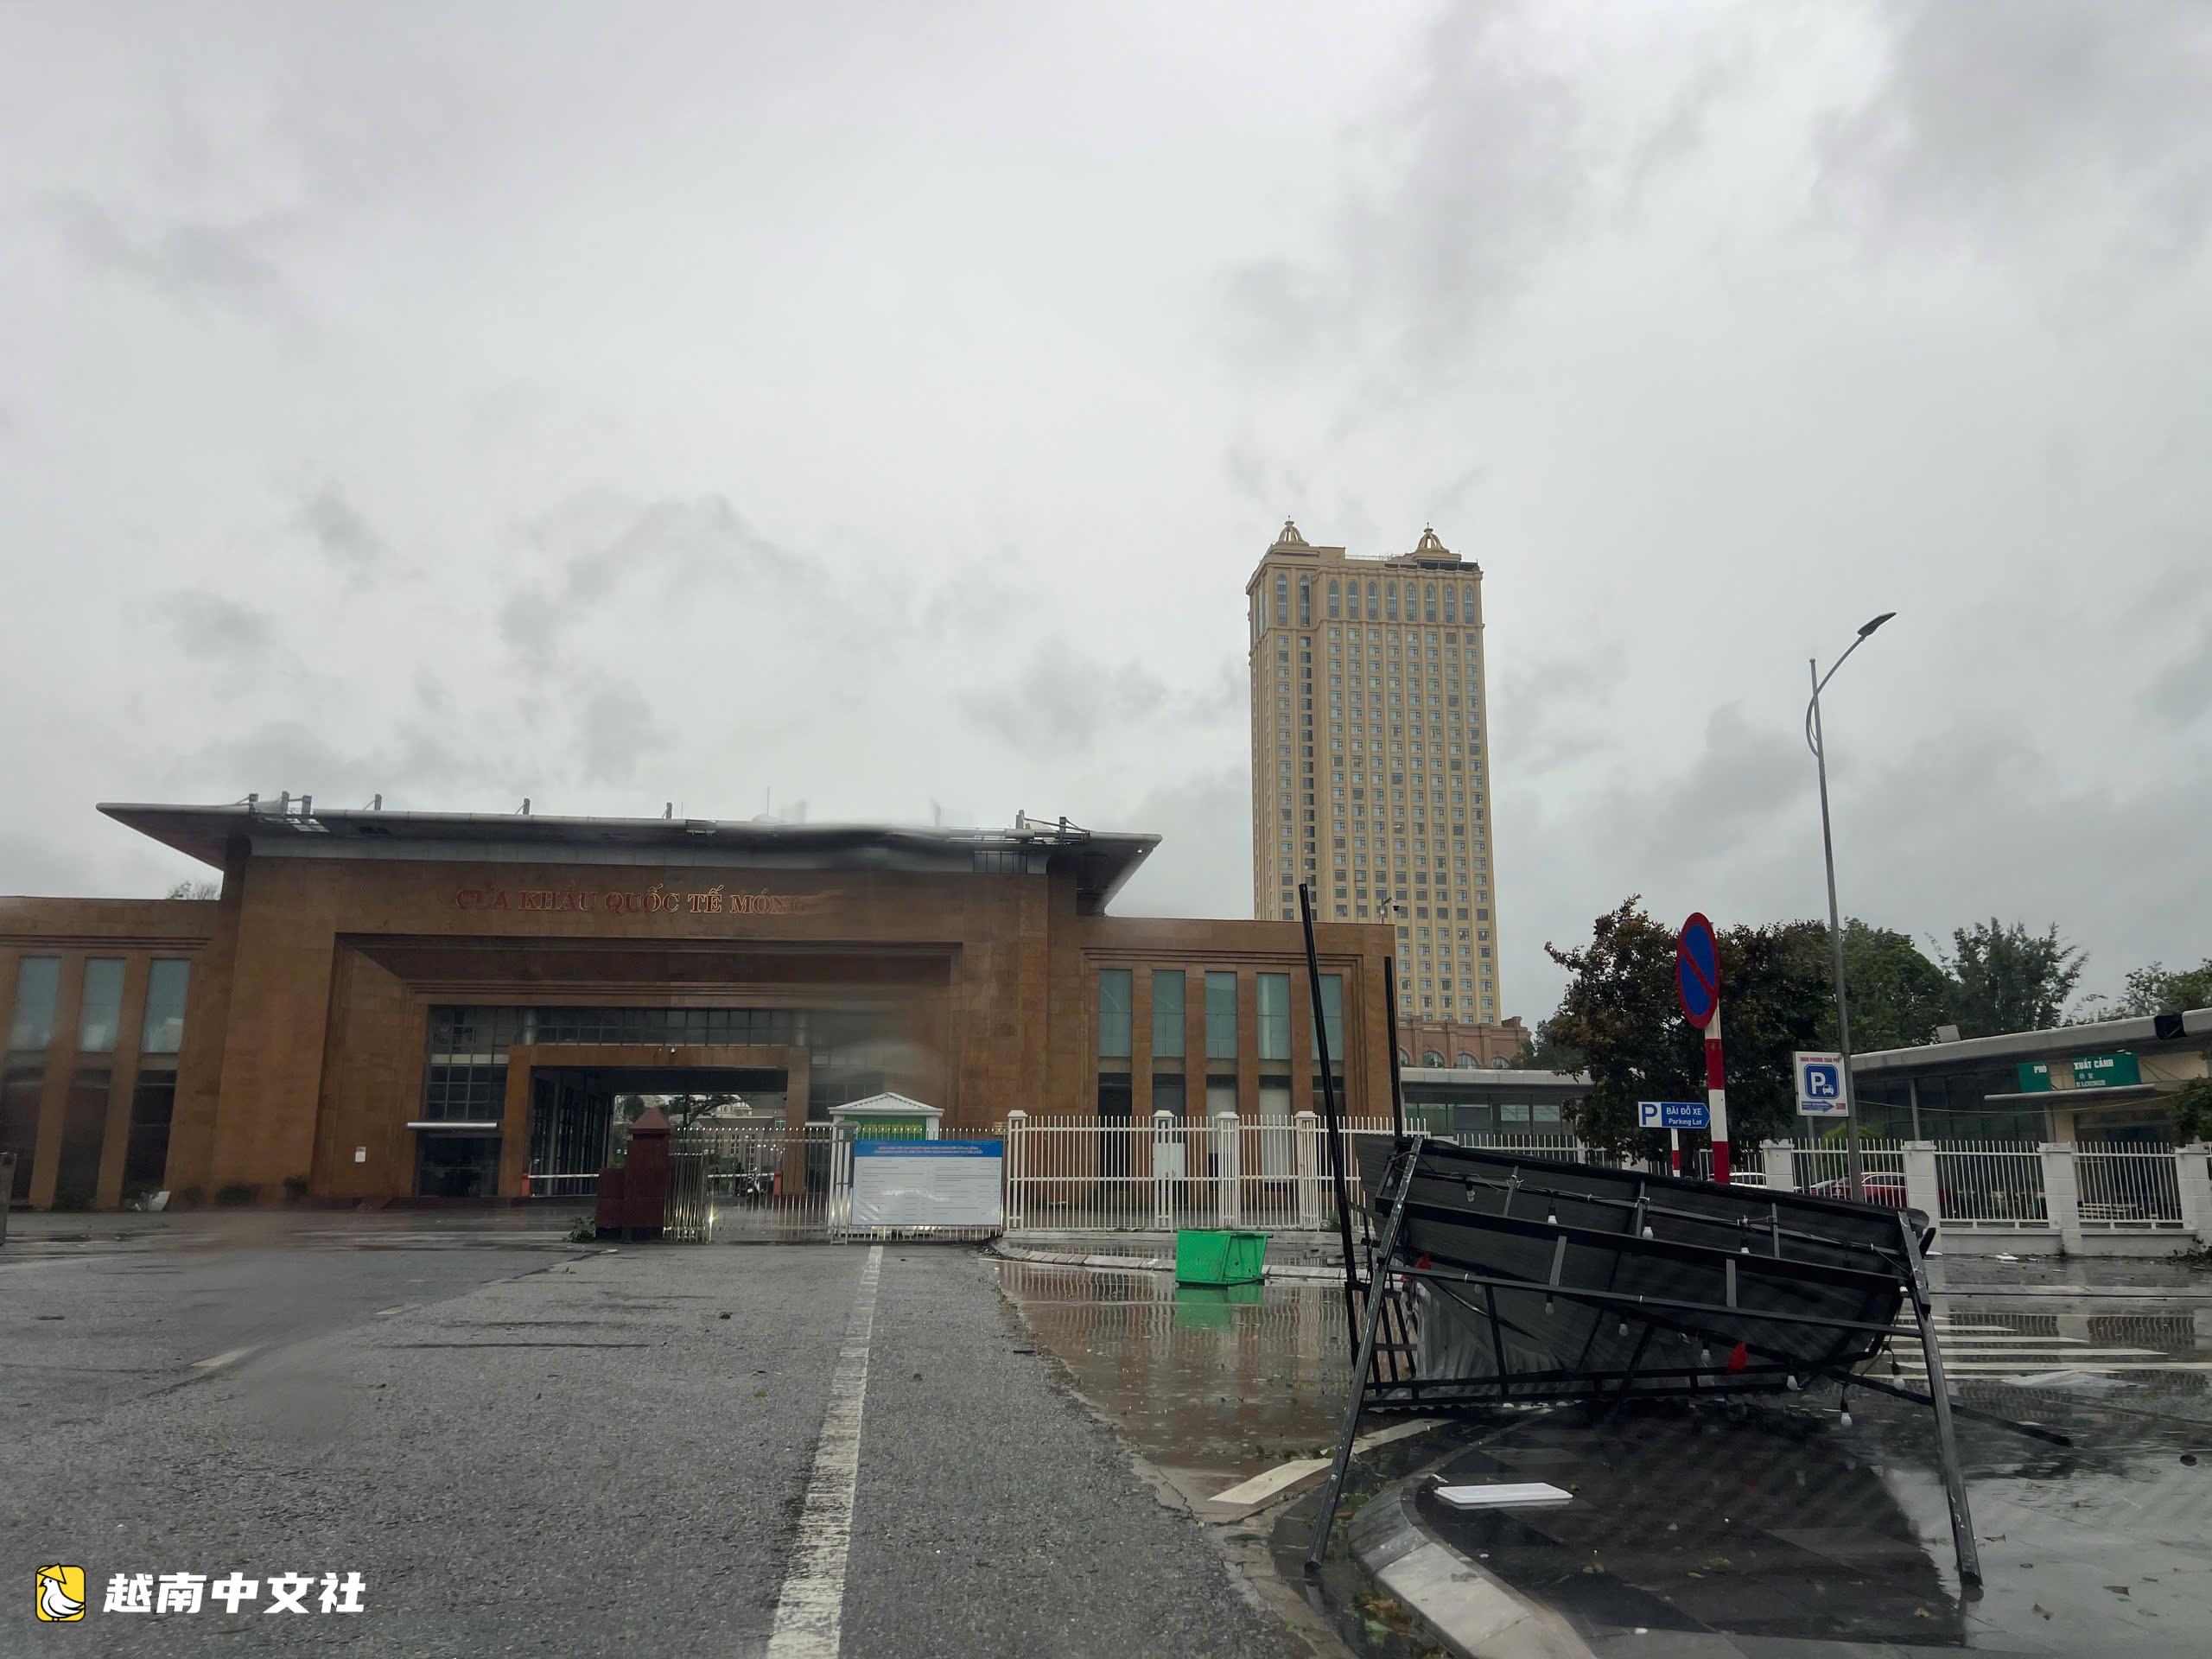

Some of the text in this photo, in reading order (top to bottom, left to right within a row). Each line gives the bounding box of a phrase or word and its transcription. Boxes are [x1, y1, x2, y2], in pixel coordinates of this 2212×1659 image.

[605, 883, 679, 914] QUỐC
[687, 884, 724, 914] TẾ
[1810, 1071, 1826, 1095] P
[1642, 1103, 1658, 1126] P
[1669, 1117, 1692, 1127] Parking
